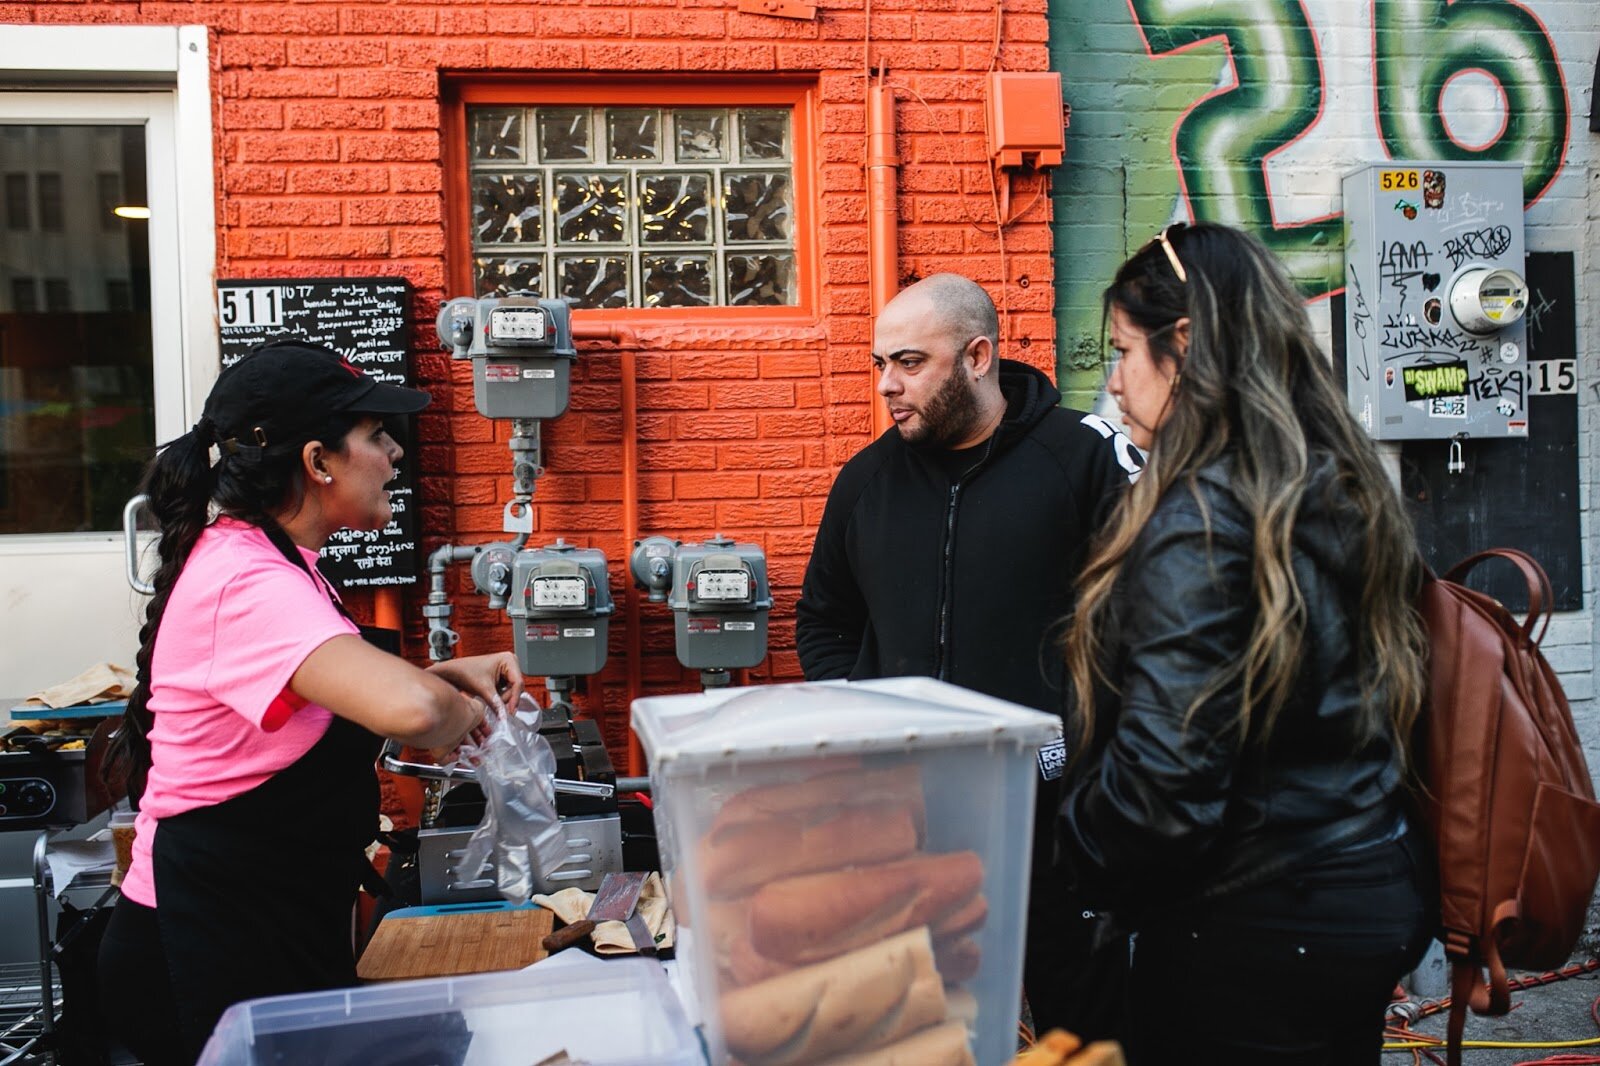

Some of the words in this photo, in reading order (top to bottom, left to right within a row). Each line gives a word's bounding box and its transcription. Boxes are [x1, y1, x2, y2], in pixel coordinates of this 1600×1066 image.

[1383, 171, 1418, 189] 526
[223, 289, 276, 324] 511
[1414, 366, 1468, 395] SWAMP
